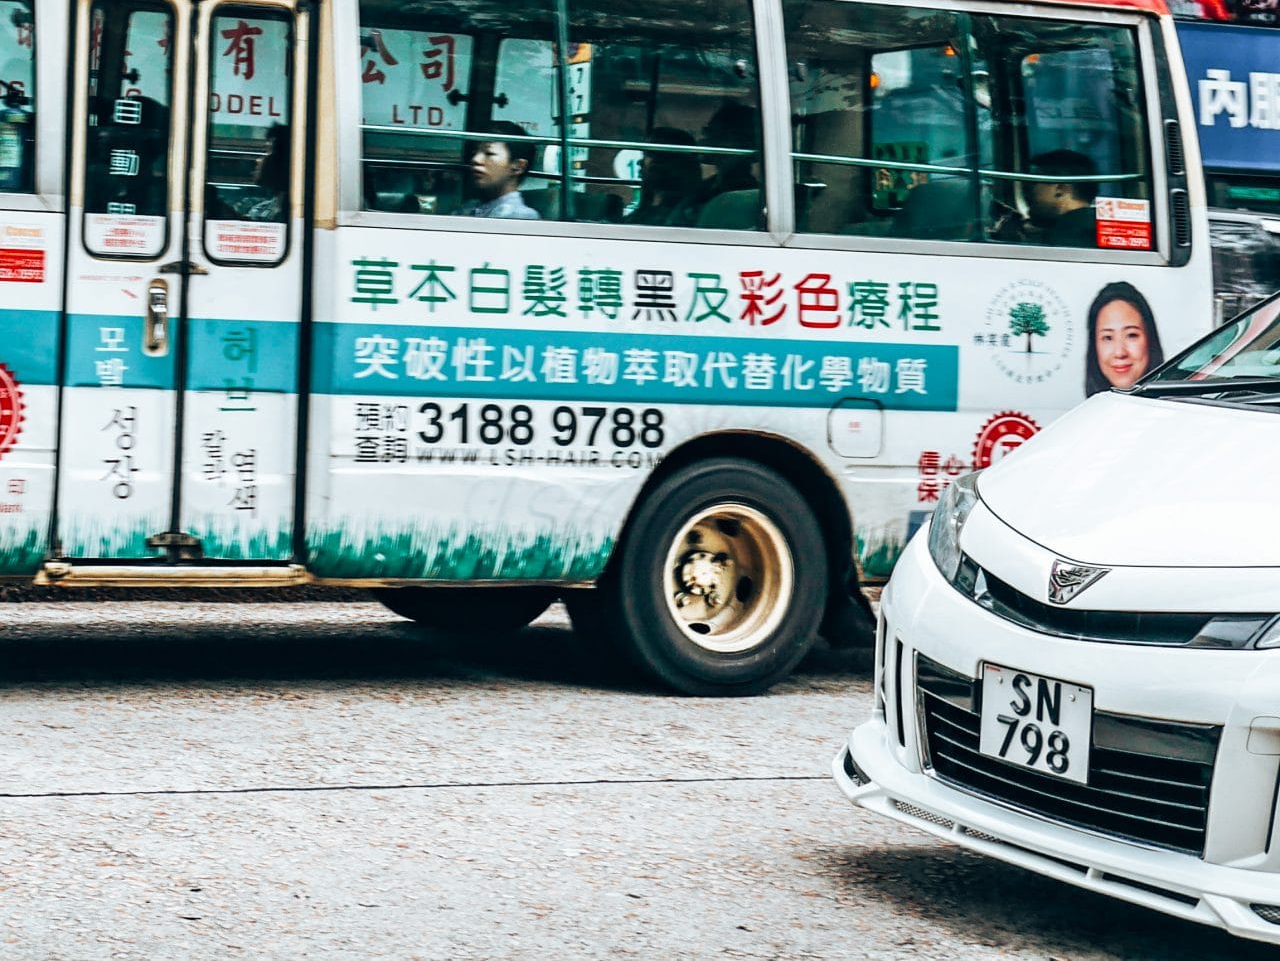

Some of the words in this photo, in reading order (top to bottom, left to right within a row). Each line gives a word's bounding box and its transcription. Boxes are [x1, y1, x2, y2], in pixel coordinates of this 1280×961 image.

[209, 91, 282, 118] ODEL
[392, 104, 452, 127] LTD.
[350, 256, 942, 332] 草本白髮轉黑及彩色療程
[352, 334, 928, 395] 突破性以植物萃取代替化學物質
[420, 402, 534, 445] 3188
[552, 406, 666, 448] 9788
[917, 478, 948, 502] 保
[1009, 673, 1062, 727] SN
[996, 713, 1070, 774] 798
